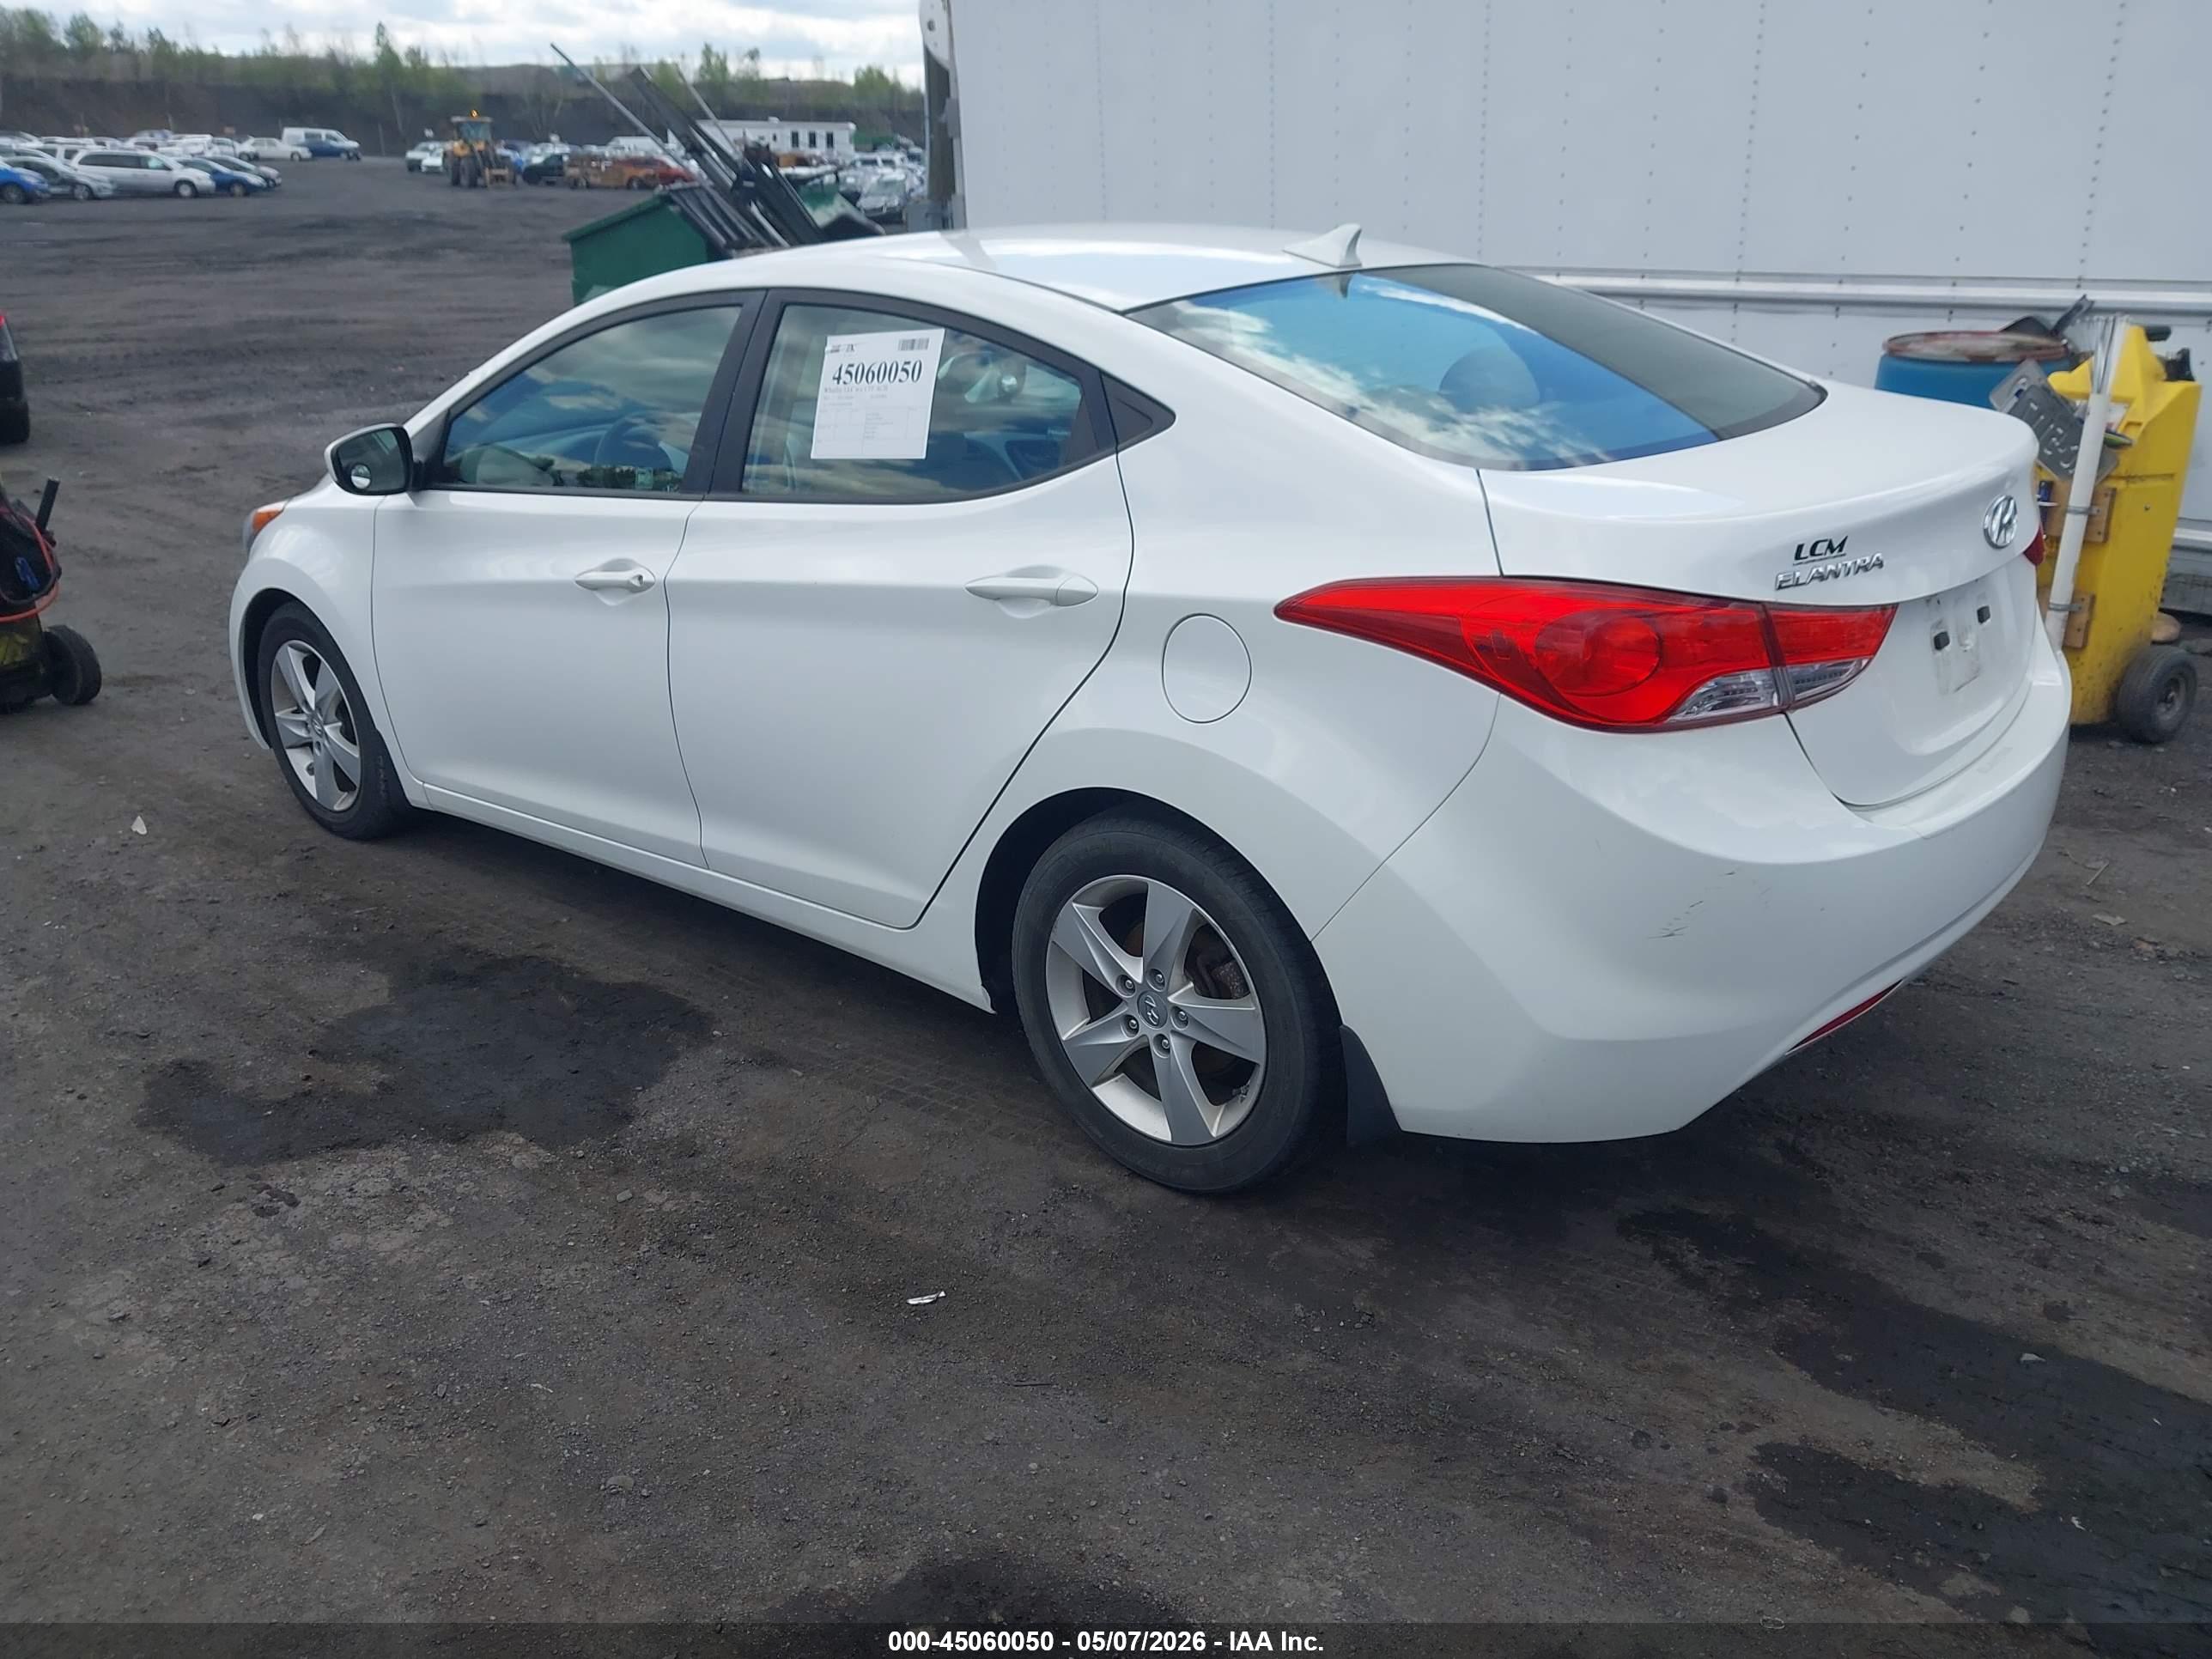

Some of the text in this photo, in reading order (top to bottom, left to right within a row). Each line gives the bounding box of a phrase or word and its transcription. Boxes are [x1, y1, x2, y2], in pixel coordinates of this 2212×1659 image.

[832, 359, 923, 386] 45060050
[1793, 535, 1849, 562] LCM
[1774, 552, 1885, 591] ELANTRA
